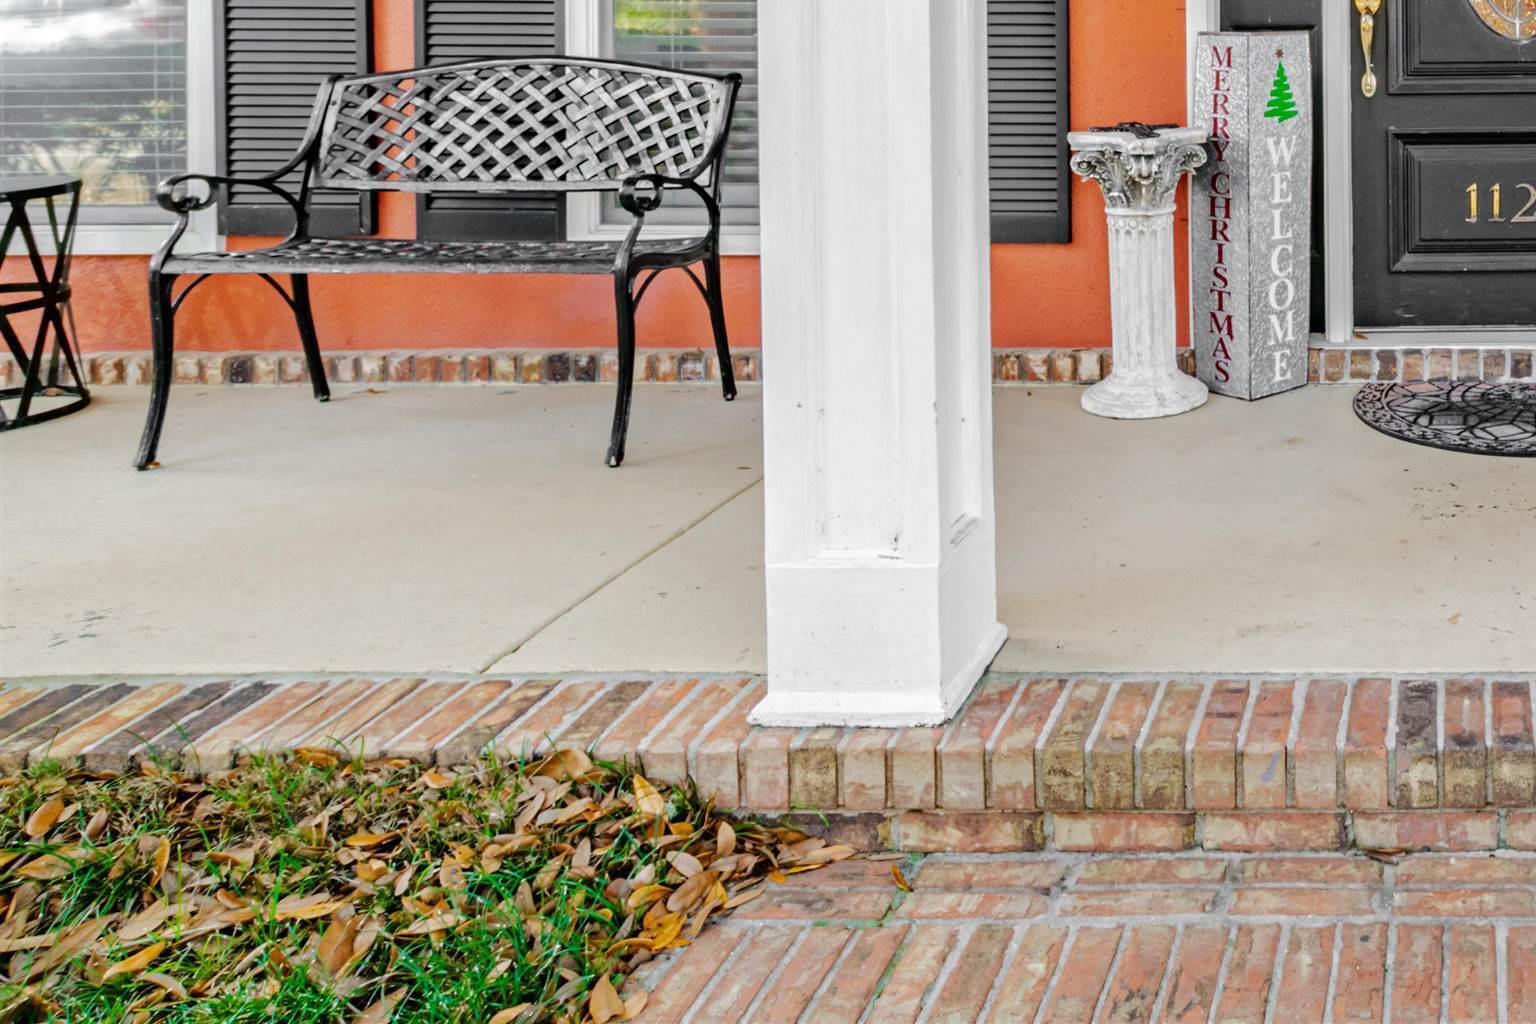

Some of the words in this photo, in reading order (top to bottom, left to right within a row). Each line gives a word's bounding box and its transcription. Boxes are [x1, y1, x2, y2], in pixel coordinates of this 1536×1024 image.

[1209, 45, 1234, 163] MERRY
[1207, 171, 1235, 383] CHRISTMAS
[1266, 134, 1298, 383] WELCOME
